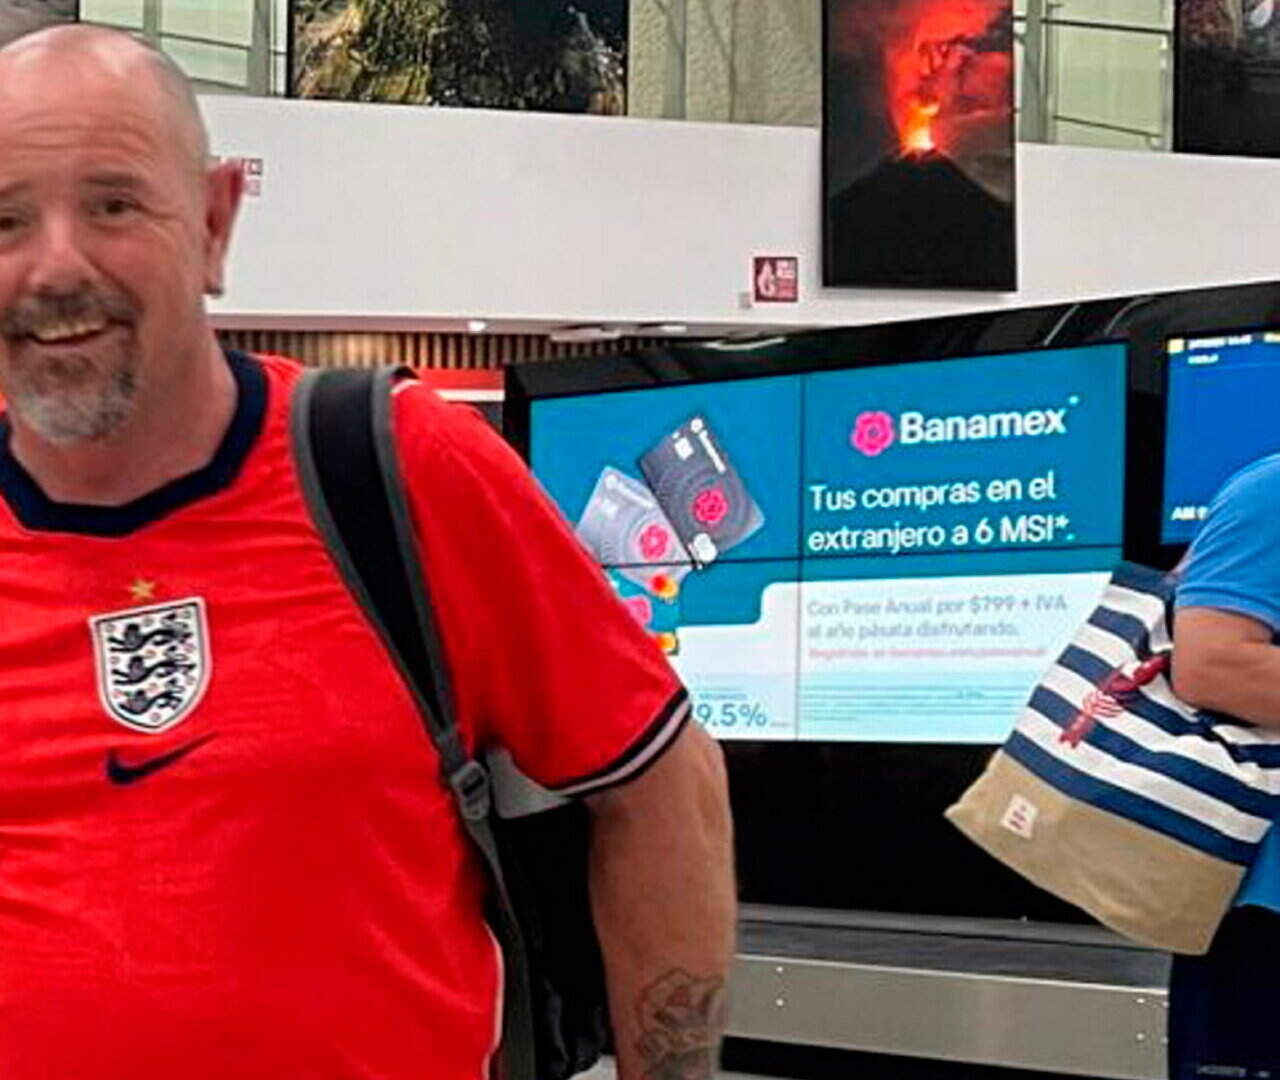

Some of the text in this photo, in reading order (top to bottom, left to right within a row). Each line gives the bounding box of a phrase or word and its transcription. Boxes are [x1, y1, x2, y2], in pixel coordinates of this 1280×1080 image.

[899, 407, 1068, 444] Banamex
[809, 469, 1056, 512] Tus compras en el
[808, 521, 945, 554] extranjero
[951, 525, 970, 546] a
[975, 517, 995, 545] 6
[807, 601, 840, 616] Con
